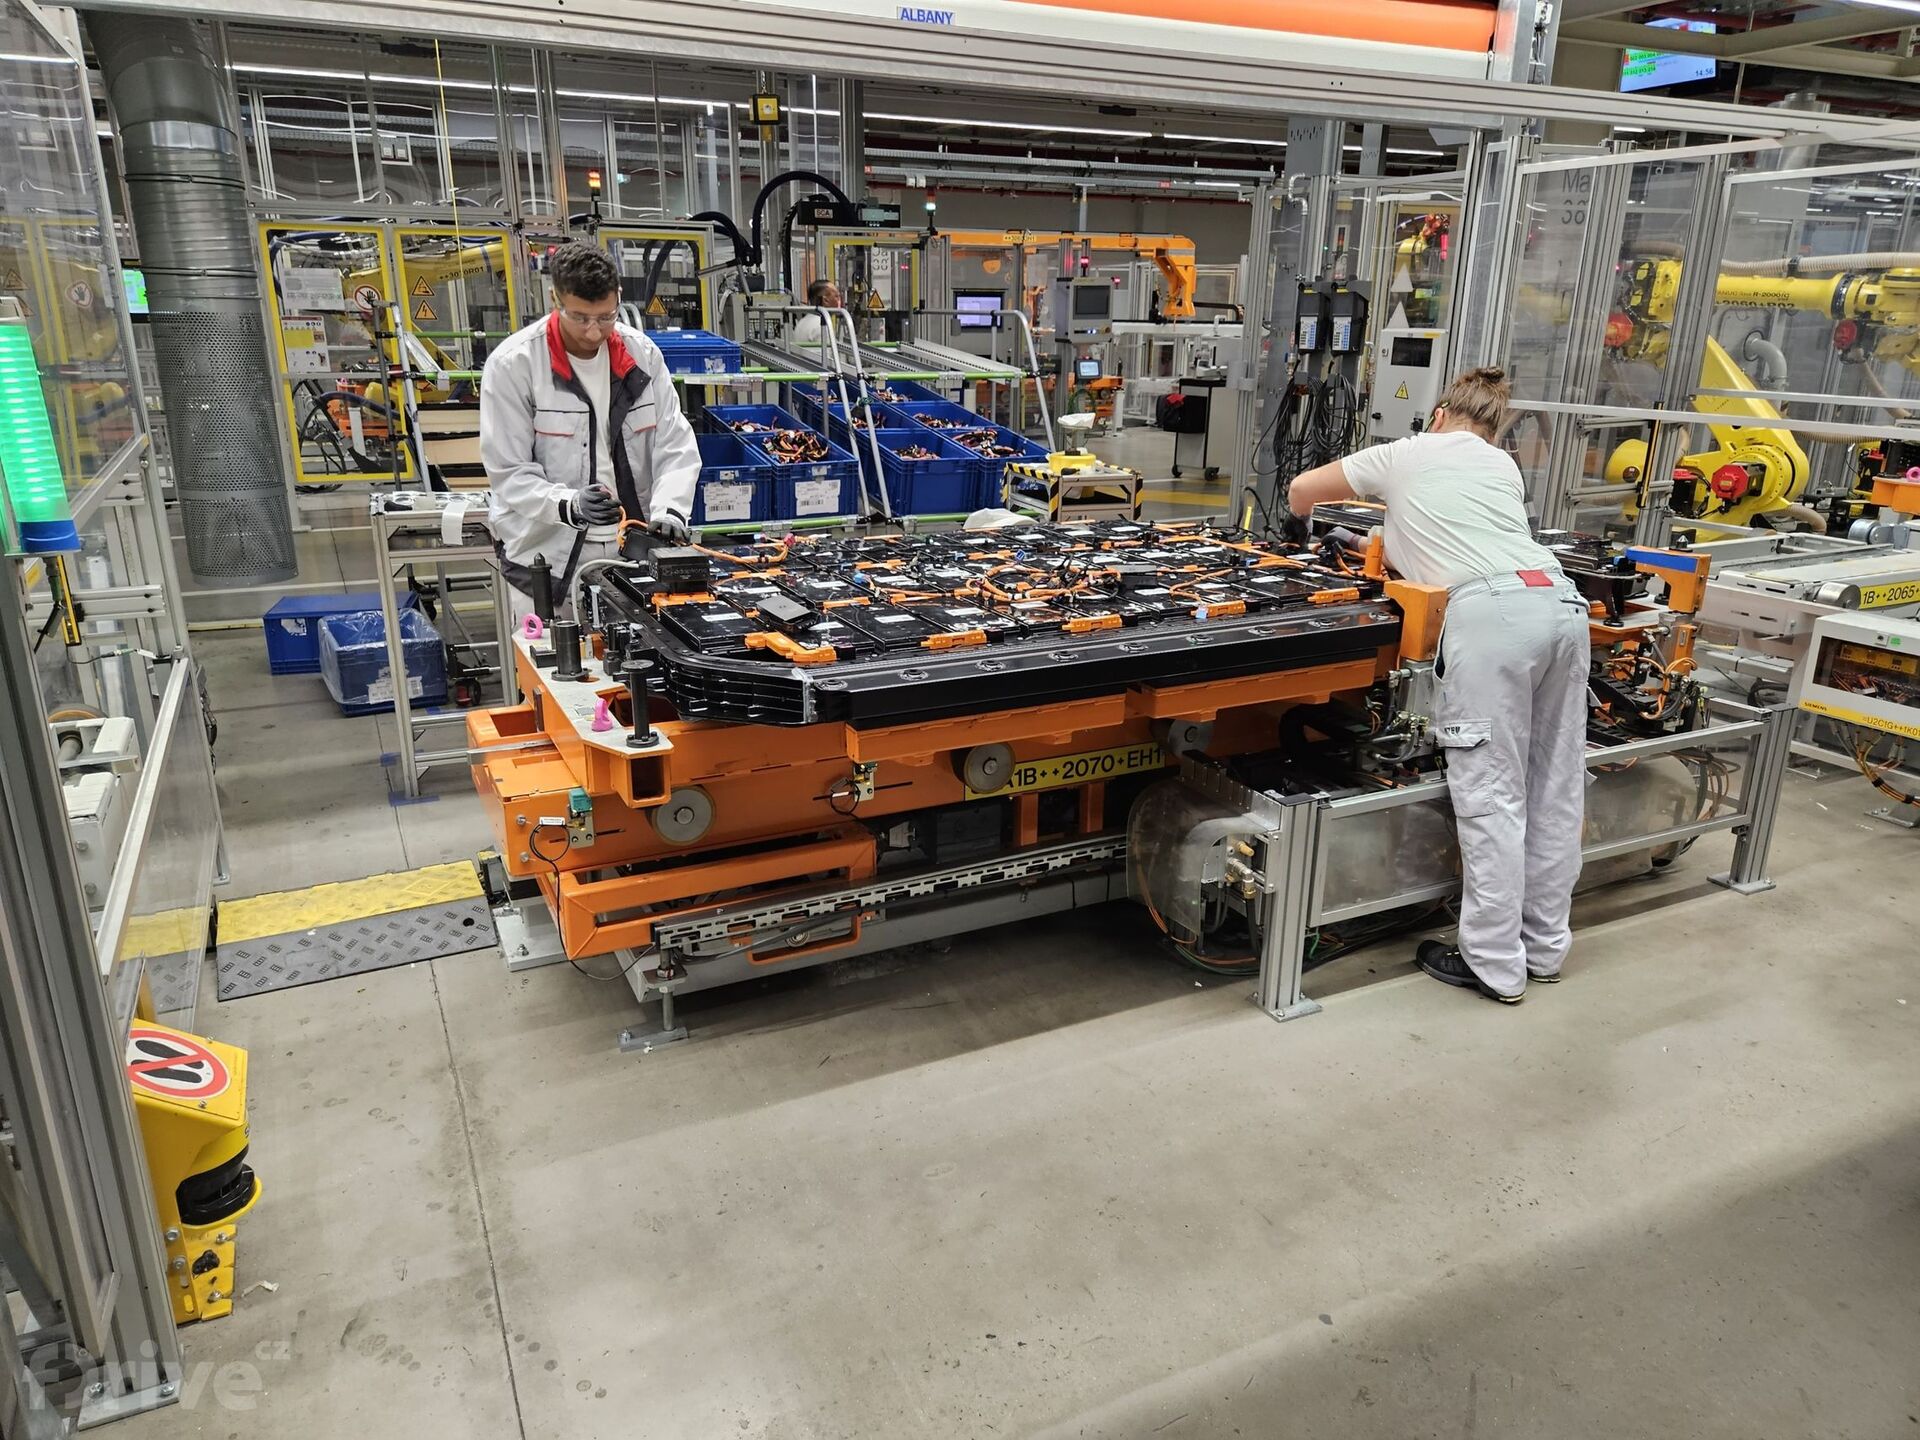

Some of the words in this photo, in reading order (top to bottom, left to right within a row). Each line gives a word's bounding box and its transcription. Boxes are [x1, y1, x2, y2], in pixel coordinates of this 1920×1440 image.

[900, 7, 954, 25] ALBANY
[1716, 289, 1738, 297] ANUC
[1804, 701, 1828, 712] SIEMENS
